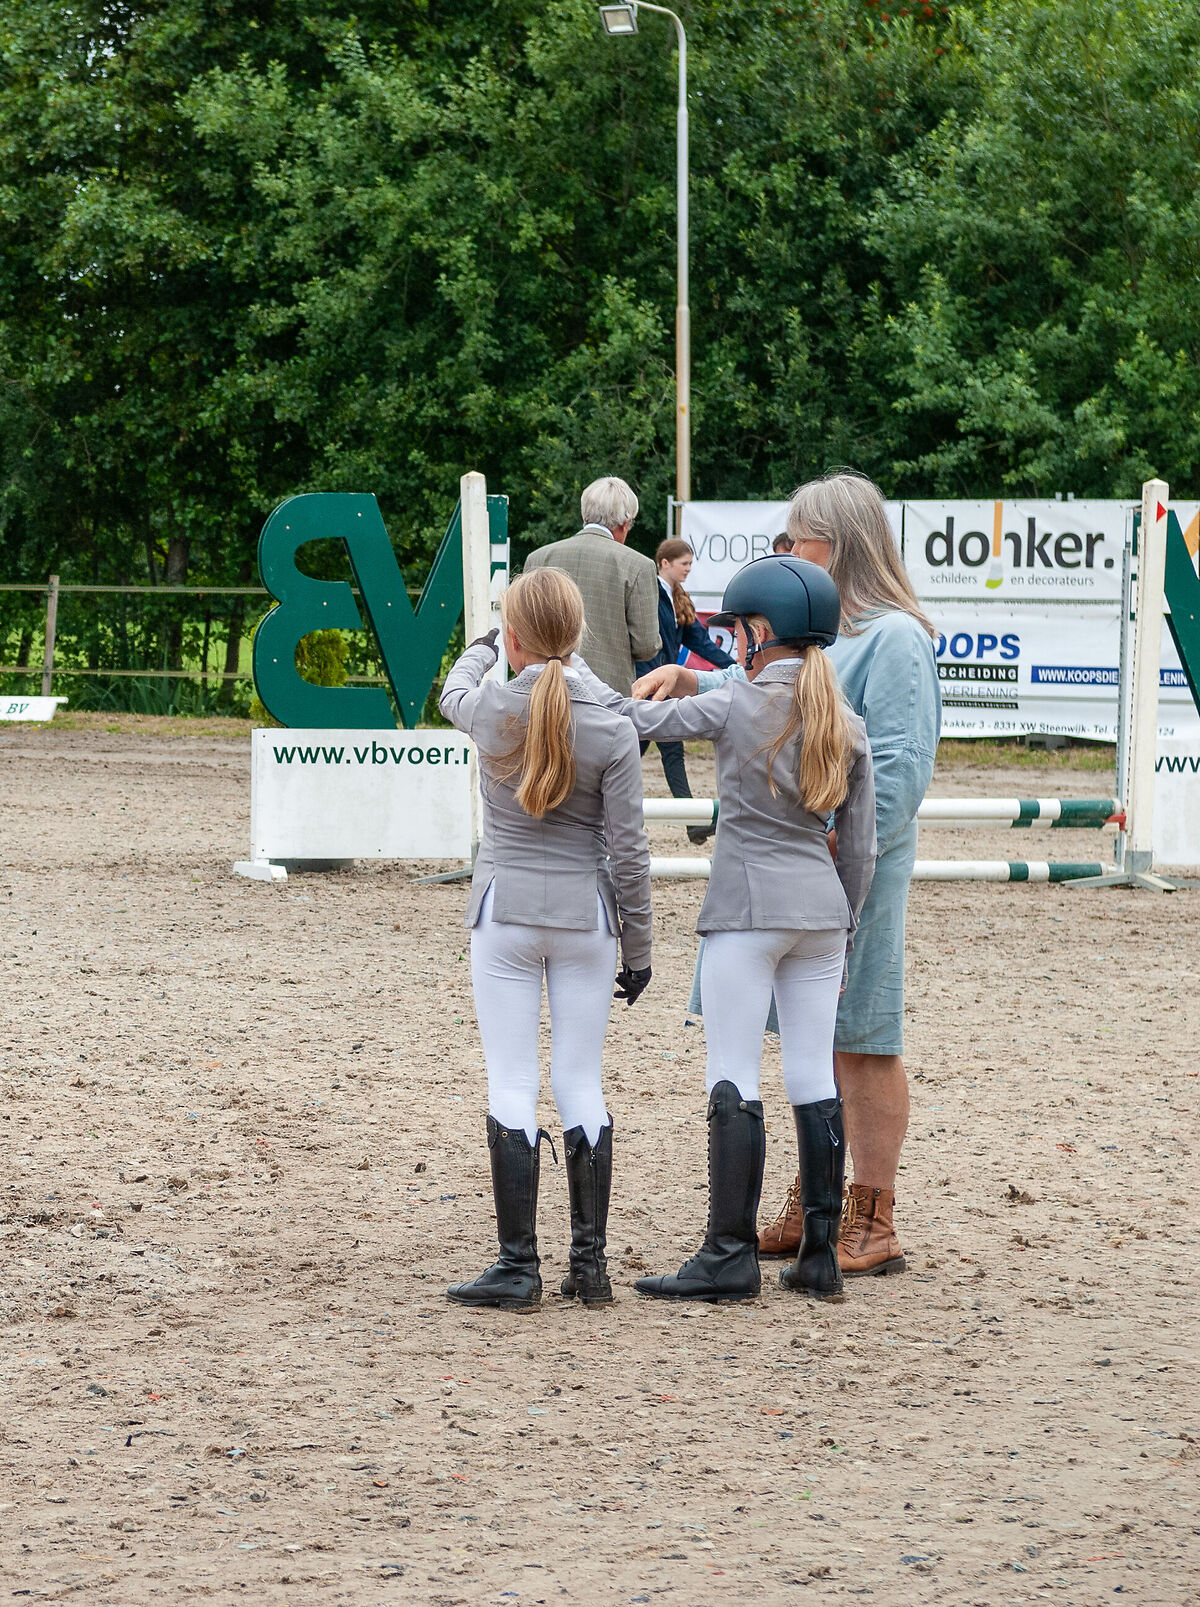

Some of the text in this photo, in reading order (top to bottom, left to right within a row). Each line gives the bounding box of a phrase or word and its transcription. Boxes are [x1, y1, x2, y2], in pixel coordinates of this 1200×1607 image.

[930, 572, 1095, 588] schilders en decorateurs
[7, 703, 31, 715] BV
